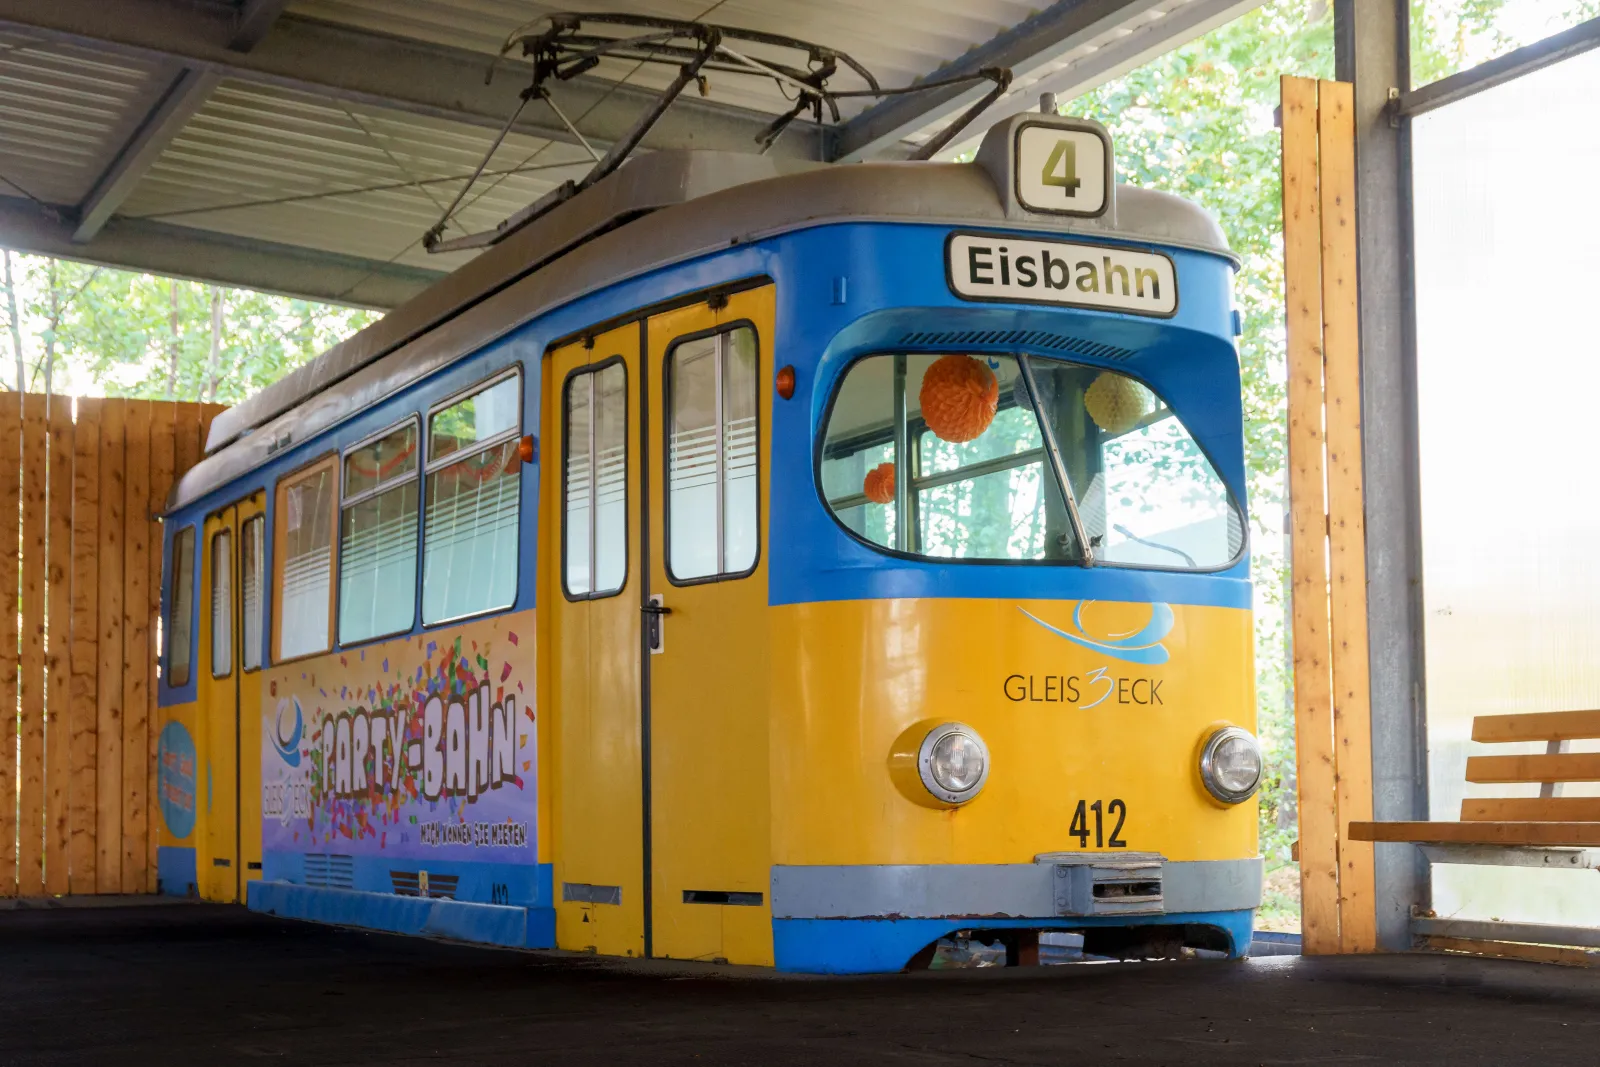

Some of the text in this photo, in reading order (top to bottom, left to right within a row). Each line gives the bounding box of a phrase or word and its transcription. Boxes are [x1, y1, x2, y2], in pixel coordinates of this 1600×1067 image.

[1041, 139, 1081, 198] 4
[967, 245, 1161, 300] Eisbahn
[322, 679, 517, 804] PARTY-BAHN
[420, 821, 440, 848] MICH
[474, 821, 489, 849] SIE
[491, 820, 528, 849] MIETEN!
[1068, 799, 1127, 848] 412
